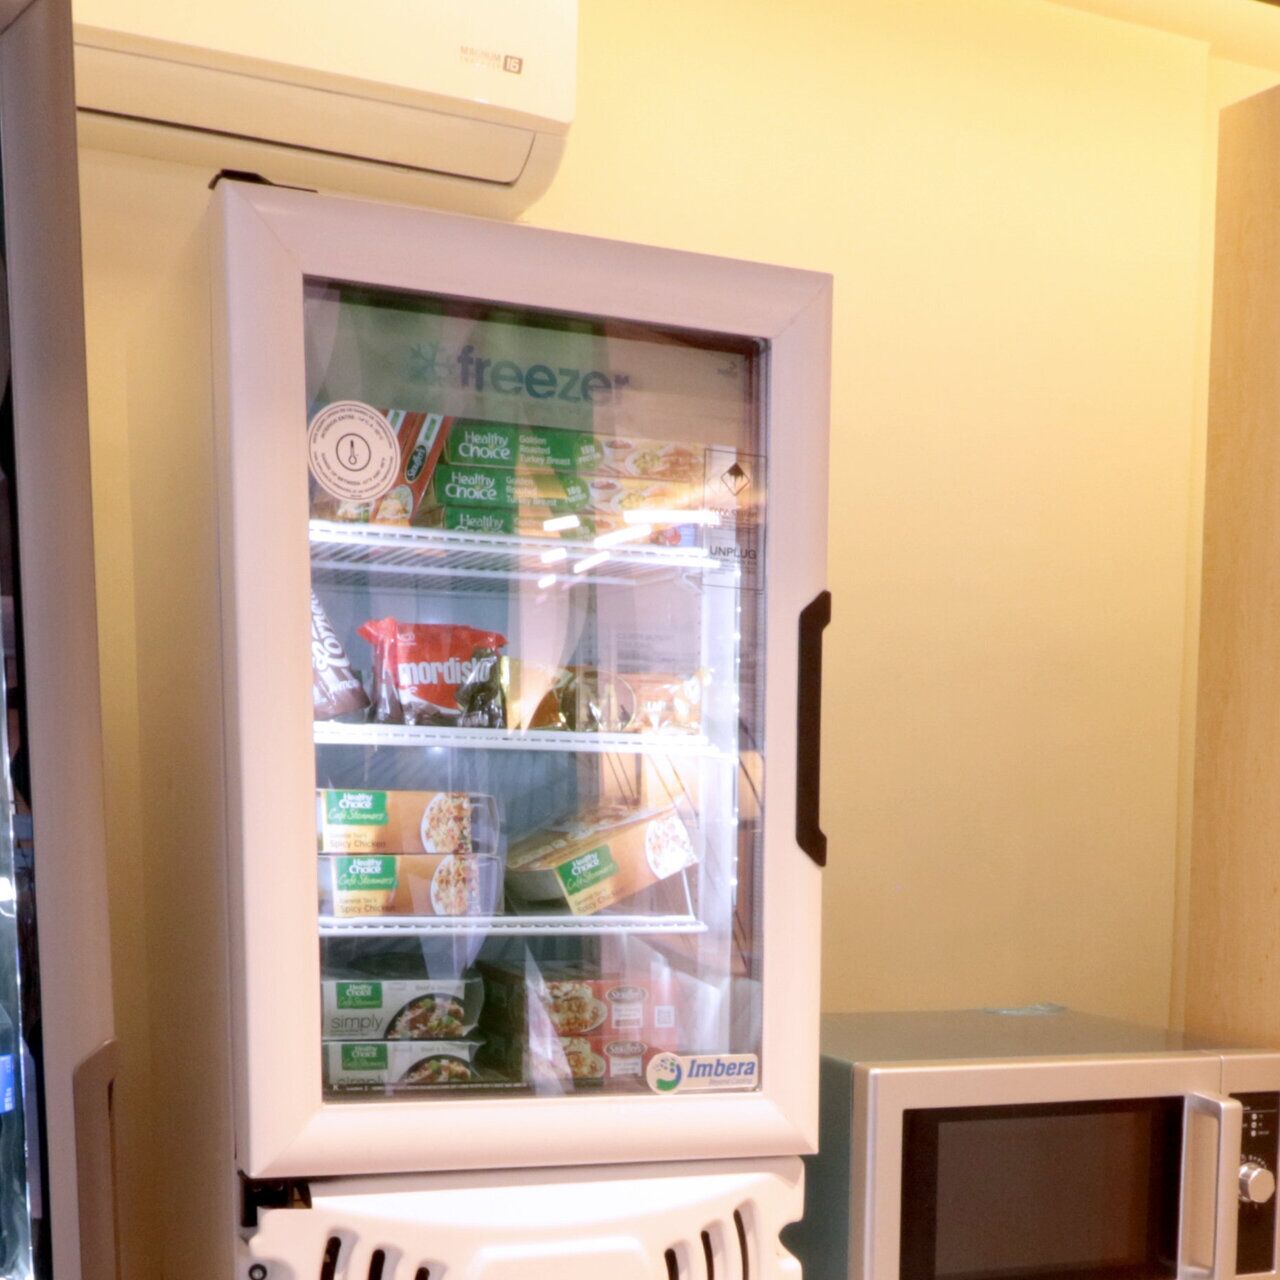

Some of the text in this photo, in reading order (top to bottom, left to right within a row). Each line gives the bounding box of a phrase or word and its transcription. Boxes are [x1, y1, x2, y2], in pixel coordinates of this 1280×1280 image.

[457, 344, 631, 403] freezer
[464, 431, 509, 448] Healthy
[458, 442, 511, 460] Choice
[451, 471, 496, 486] Healthy
[445, 483, 497, 500] Choice
[460, 513, 504, 529] Healthy
[709, 545, 758, 560] UNPLUG
[330, 1014, 384, 1034] simply
[686, 1058, 756, 1078] Imbera
